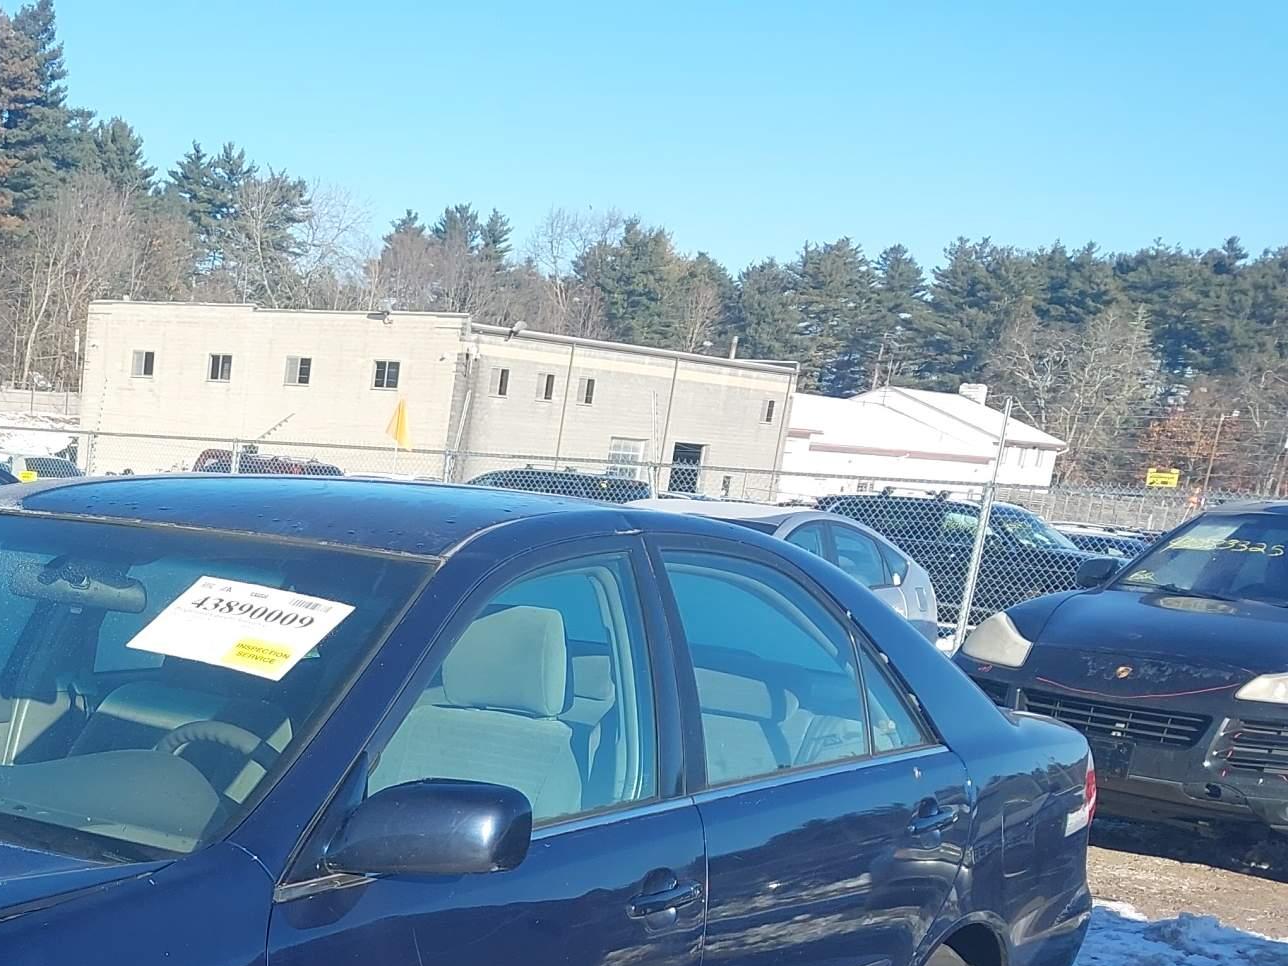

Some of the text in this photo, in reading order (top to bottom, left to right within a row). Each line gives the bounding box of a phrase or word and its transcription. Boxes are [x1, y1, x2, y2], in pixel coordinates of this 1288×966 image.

[191, 595, 315, 629] 43890009
[236, 643, 290, 659] INSPECTION
[236, 651, 275, 664] SERVICE
